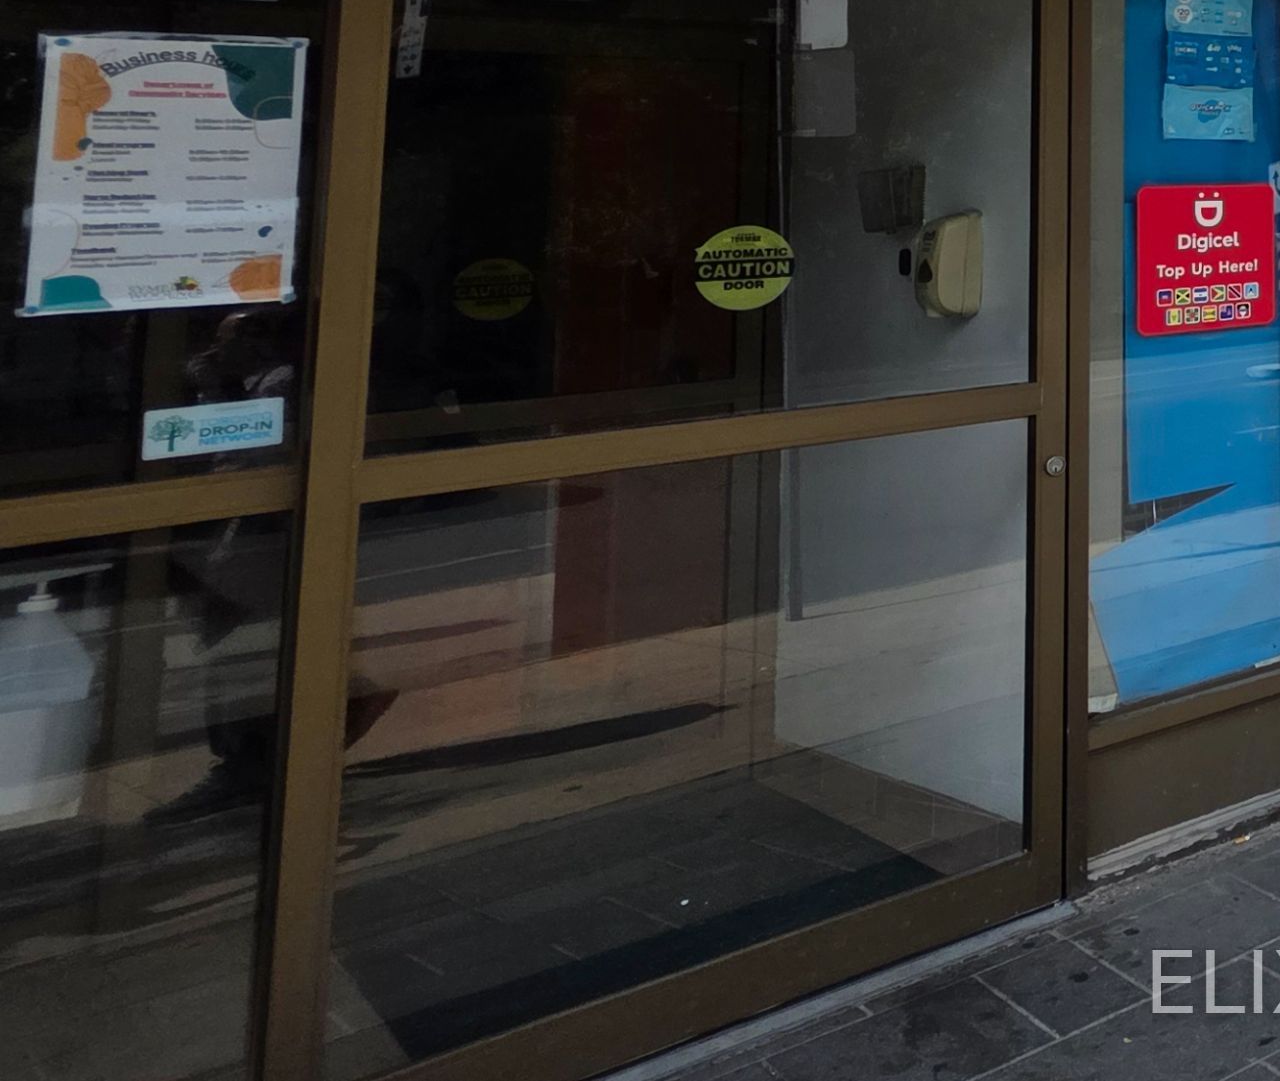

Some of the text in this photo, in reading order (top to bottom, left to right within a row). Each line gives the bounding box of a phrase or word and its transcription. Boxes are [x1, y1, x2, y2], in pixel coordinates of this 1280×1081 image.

[100, 48, 197, 78] Business
[1177, 231, 1240, 253] Digicel
[702, 248, 788, 260] AUTOMATIC
[698, 260, 790, 279] CAUTION
[1157, 258, 1258, 280] Top Up Here!
[723, 280, 765, 291] DOOR
[199, 420, 273, 438] DROP-IN
[198, 431, 272, 447] NETWORK
